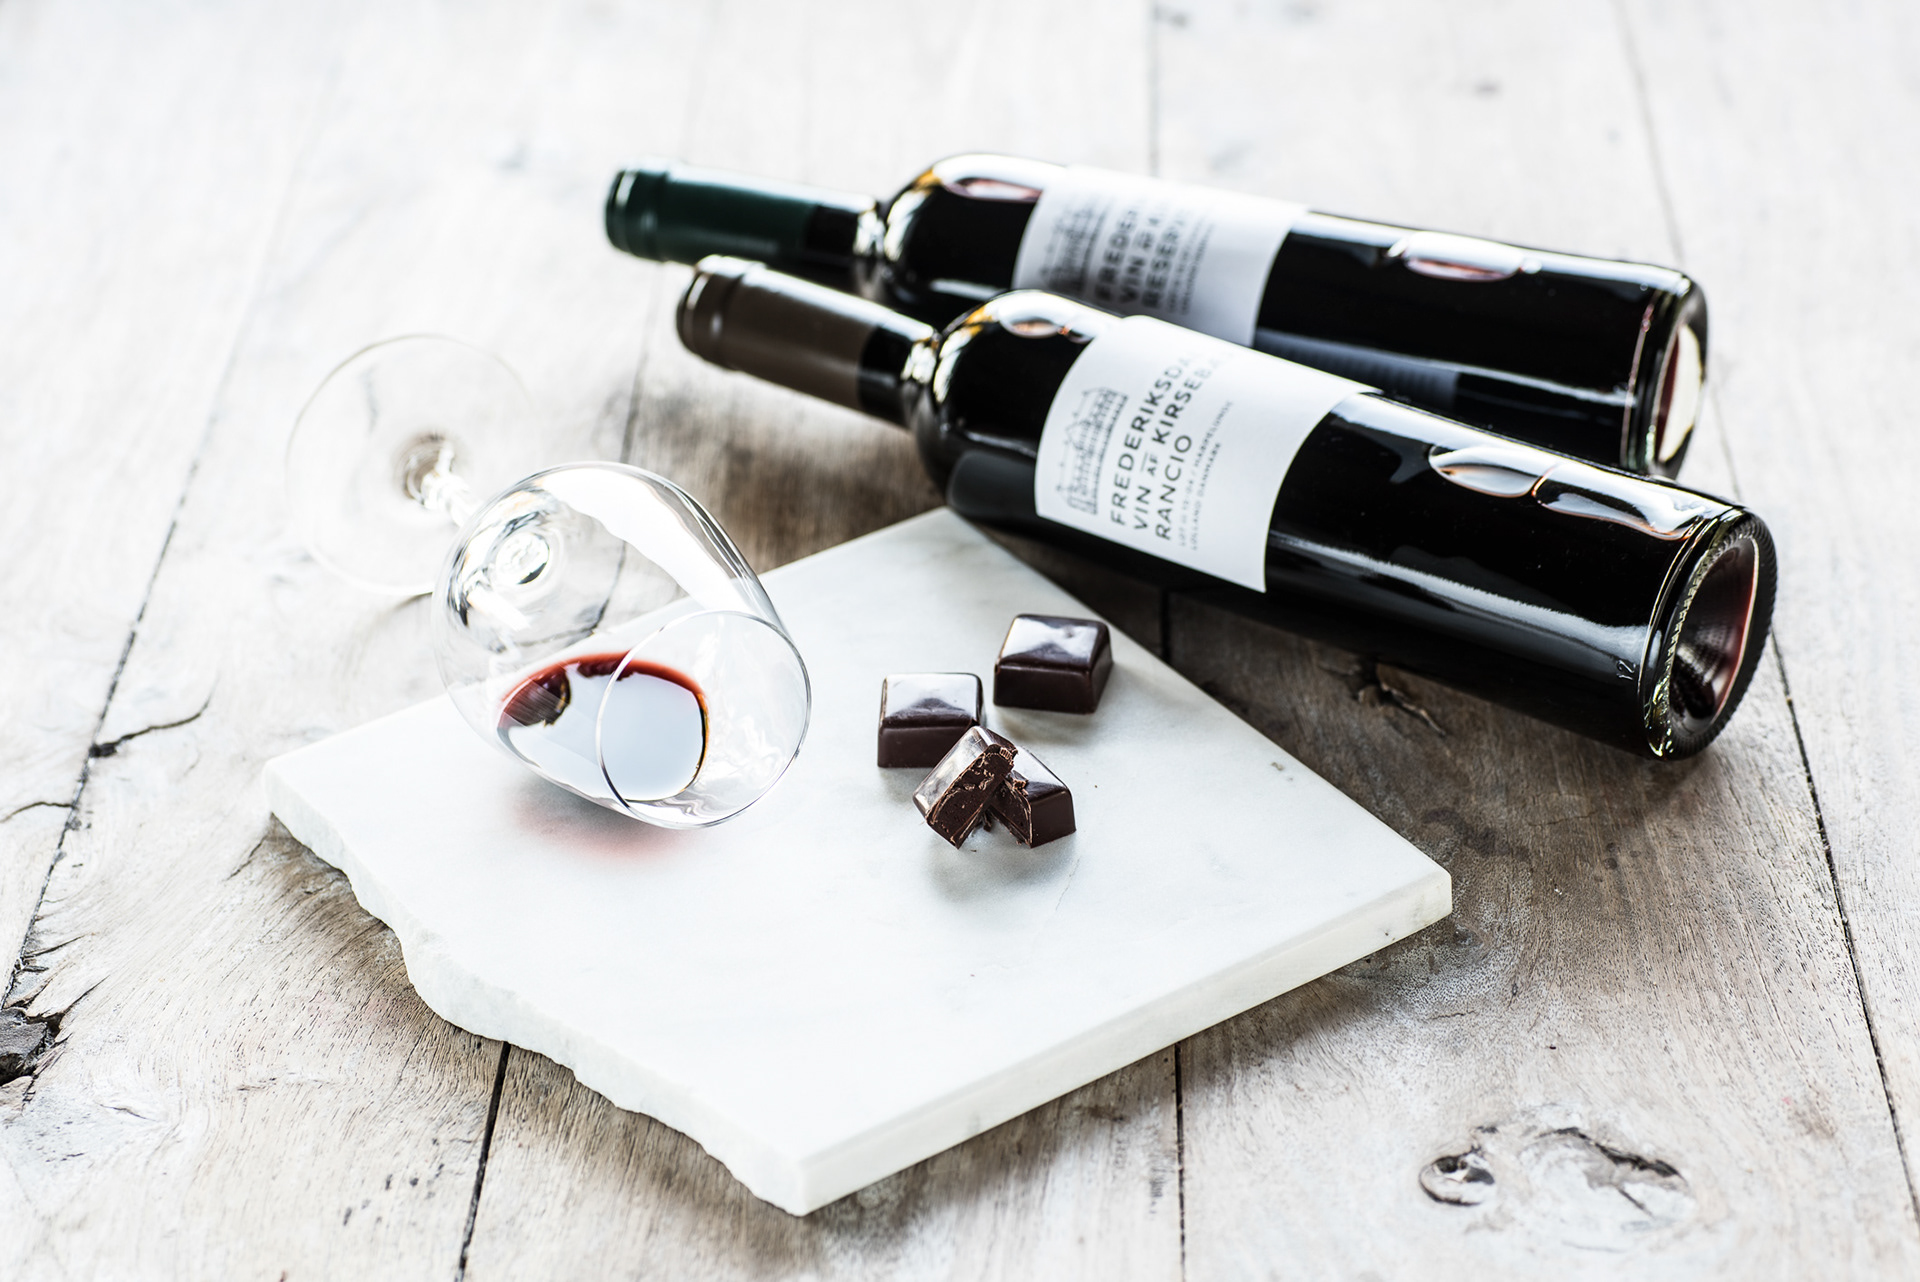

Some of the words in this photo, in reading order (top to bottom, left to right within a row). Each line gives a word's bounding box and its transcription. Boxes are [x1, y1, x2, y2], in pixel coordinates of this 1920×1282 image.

[1119, 256, 1147, 304] VIN
[1134, 486, 1151, 529] VIN
[1146, 453, 1159, 477] AF
[1155, 435, 1192, 541] RANCIO
